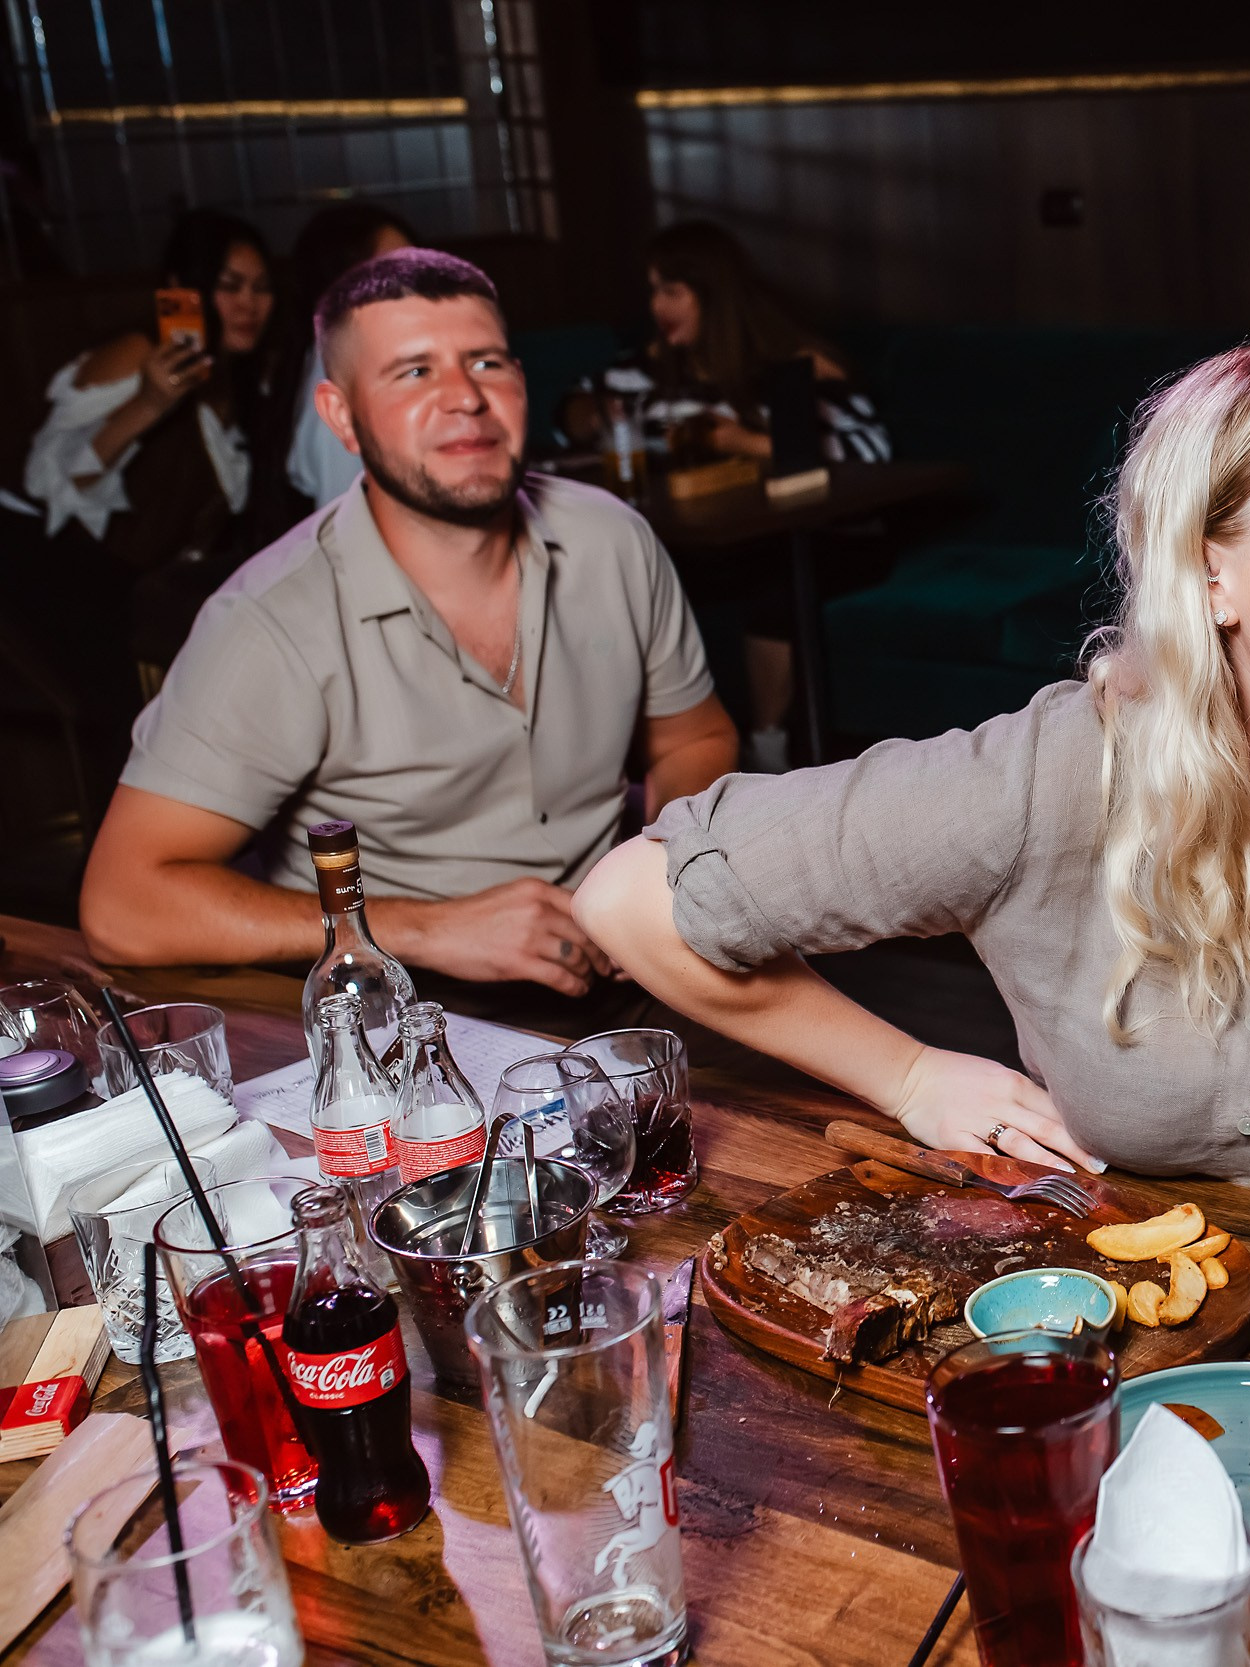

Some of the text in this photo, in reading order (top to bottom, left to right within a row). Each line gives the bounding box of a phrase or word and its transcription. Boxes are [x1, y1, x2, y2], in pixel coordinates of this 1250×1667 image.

[356, 877, 363, 894] 5
[287, 1346, 377, 1391] Coca-Cola
[309, 1391, 345, 1400] CLASSIC
